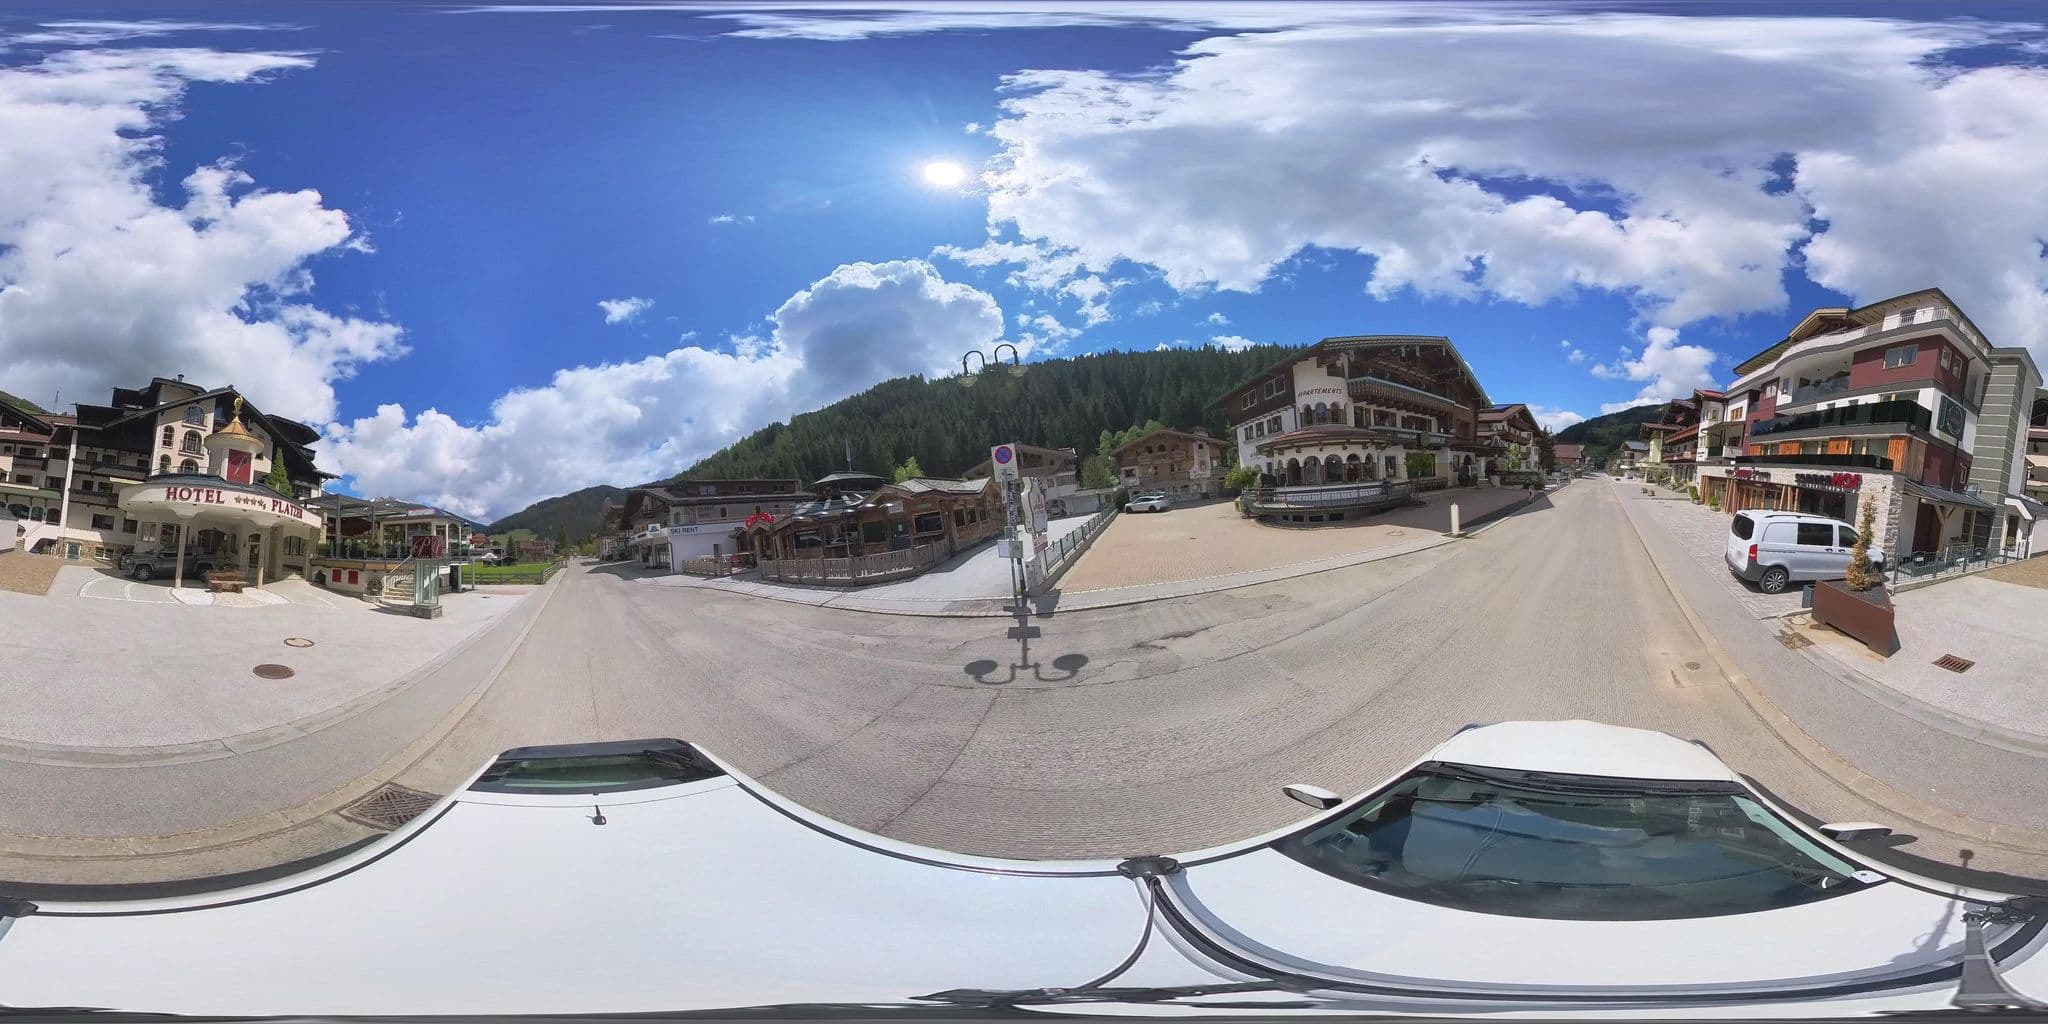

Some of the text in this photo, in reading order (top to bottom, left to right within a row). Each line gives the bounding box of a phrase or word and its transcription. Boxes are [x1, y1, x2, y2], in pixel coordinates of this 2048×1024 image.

[165, 486, 225, 504] HOTEL
[271, 499, 303, 519] PLATZER
[670, 526, 699, 535] SKI RENT
